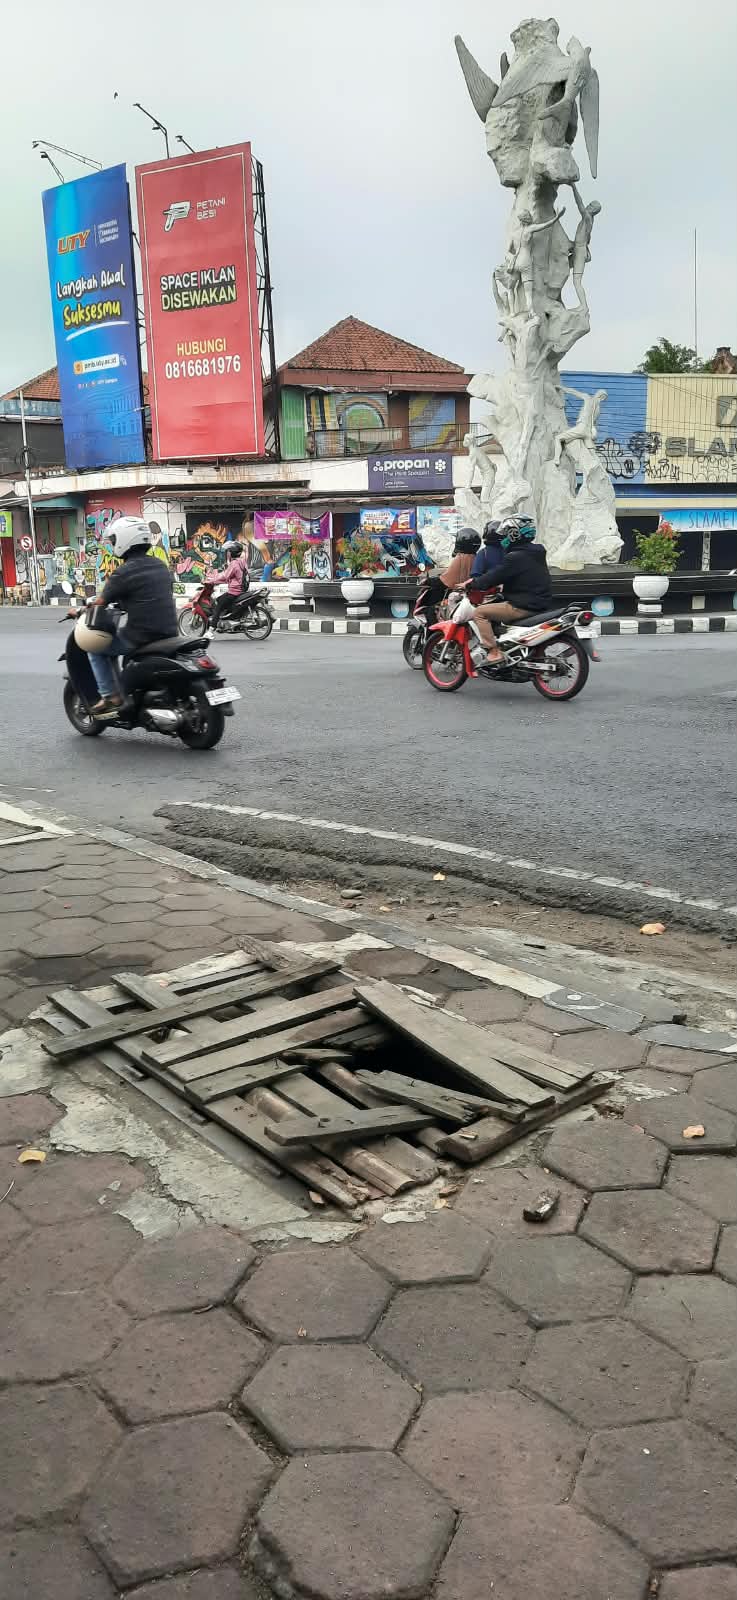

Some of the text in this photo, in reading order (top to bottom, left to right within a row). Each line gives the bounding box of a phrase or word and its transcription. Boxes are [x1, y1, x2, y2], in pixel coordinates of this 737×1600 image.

[196, 197, 226, 210] PETANI
[196, 209, 216, 221] BESI
[57, 230, 90, 253] UTY
[56, 263, 126, 298] Langkah Awal
[160, 265, 236, 291] SPACE IKLAN
[161, 285, 237, 310] DISEWAKAN
[63, 300, 121, 326] Suksesmu
[176, 338, 226, 356] HUBUNGI
[165, 355, 241, 379] 0816681976
[384, 459, 430, 472] propan
[23, 537, 30, 548] S
